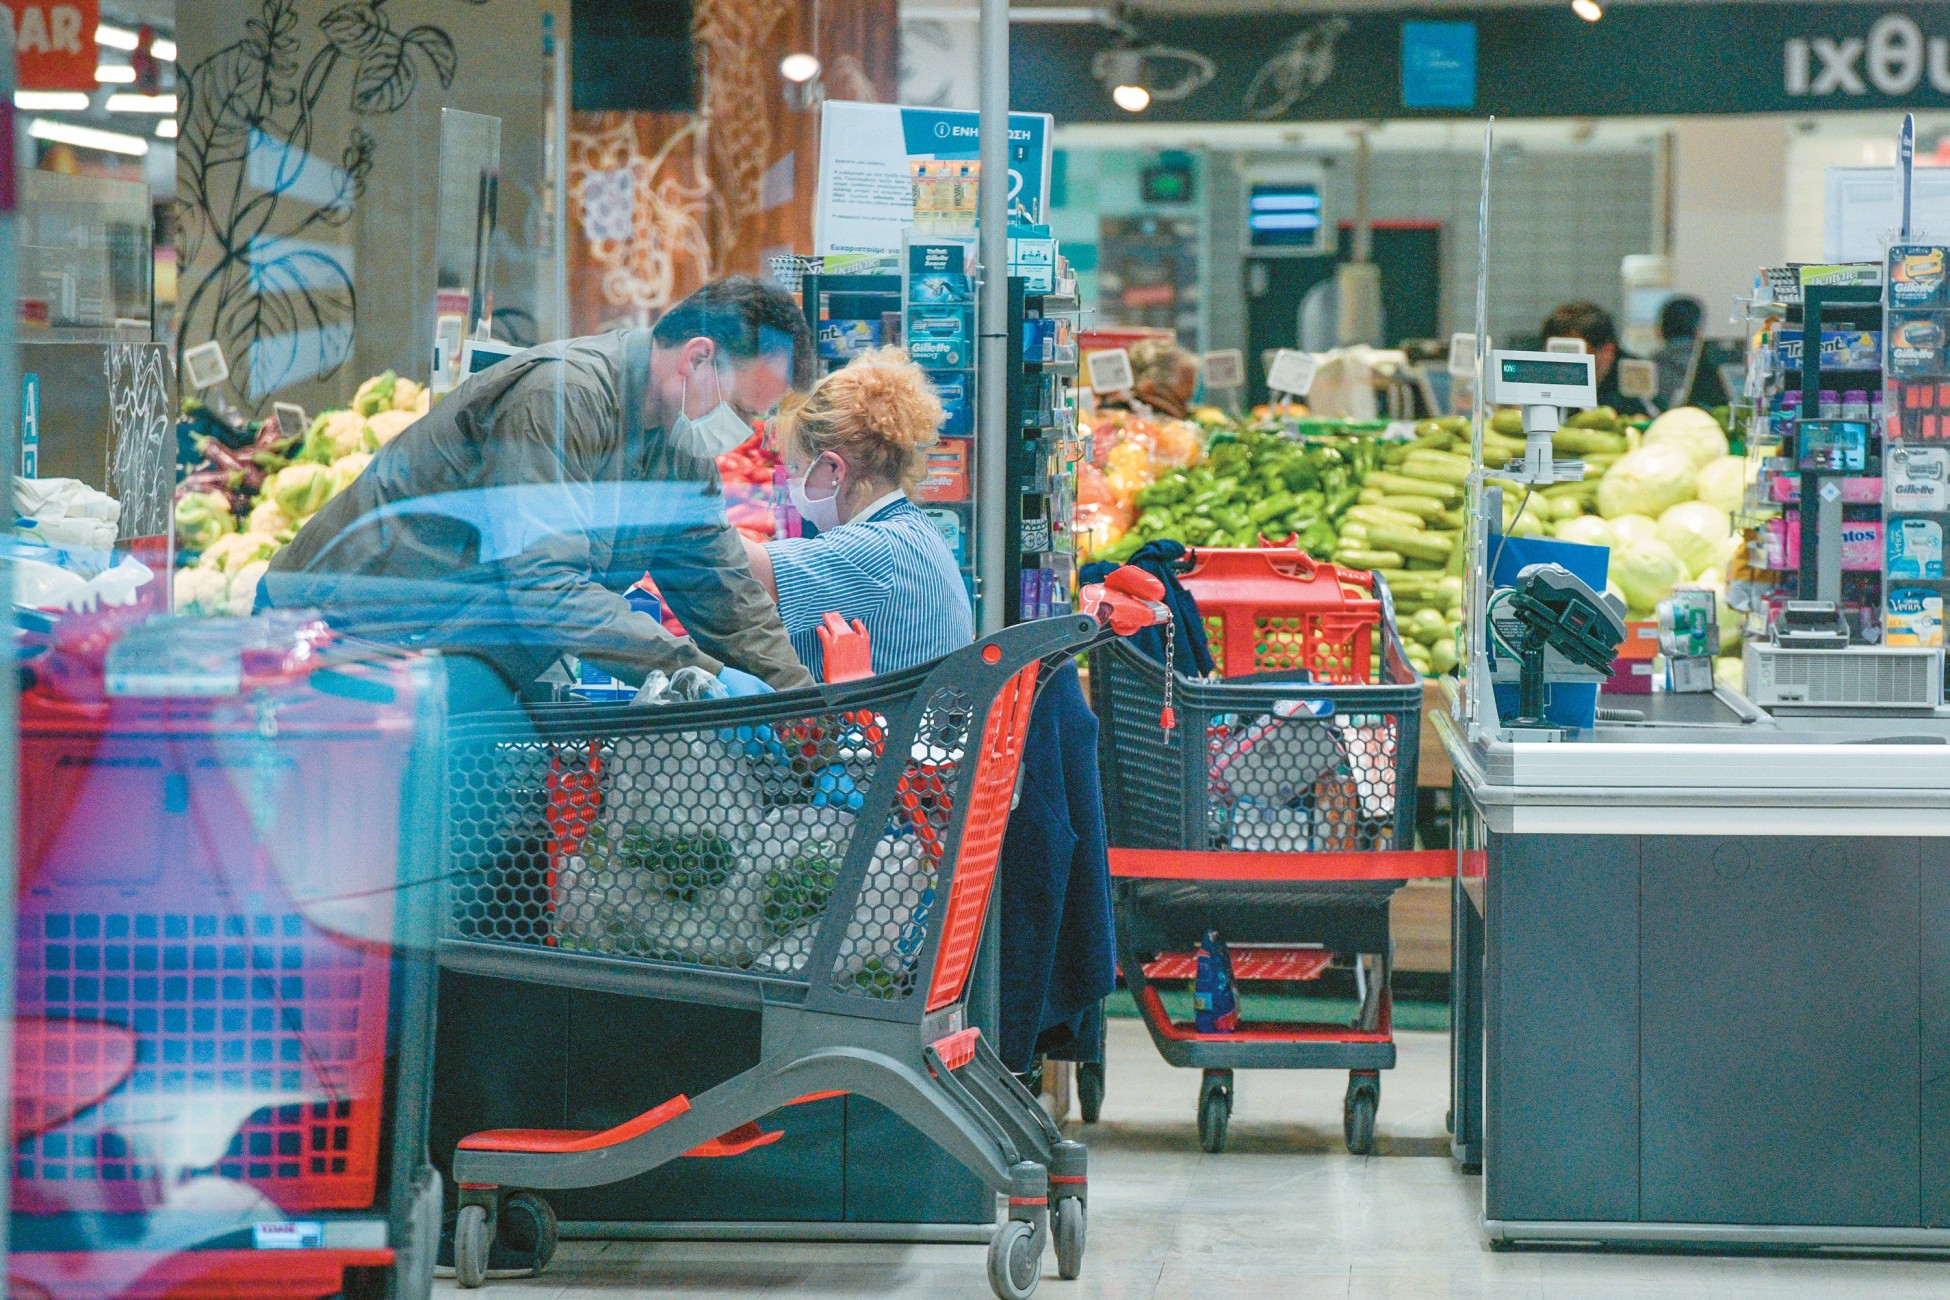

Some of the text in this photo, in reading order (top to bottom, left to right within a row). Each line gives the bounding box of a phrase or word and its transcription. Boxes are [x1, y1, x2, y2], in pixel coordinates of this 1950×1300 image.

[952, 126, 1031, 141] ΕΝΗΩΣΗ
[1894, 282, 1935, 293] Gillette
[911, 342, 951, 353] Gillette
[1779, 336, 1844, 358] Trent
[1894, 484, 1935, 495] Gillette
[1842, 528, 1876, 542] ntos
[1889, 598, 1922, 612] Venus
